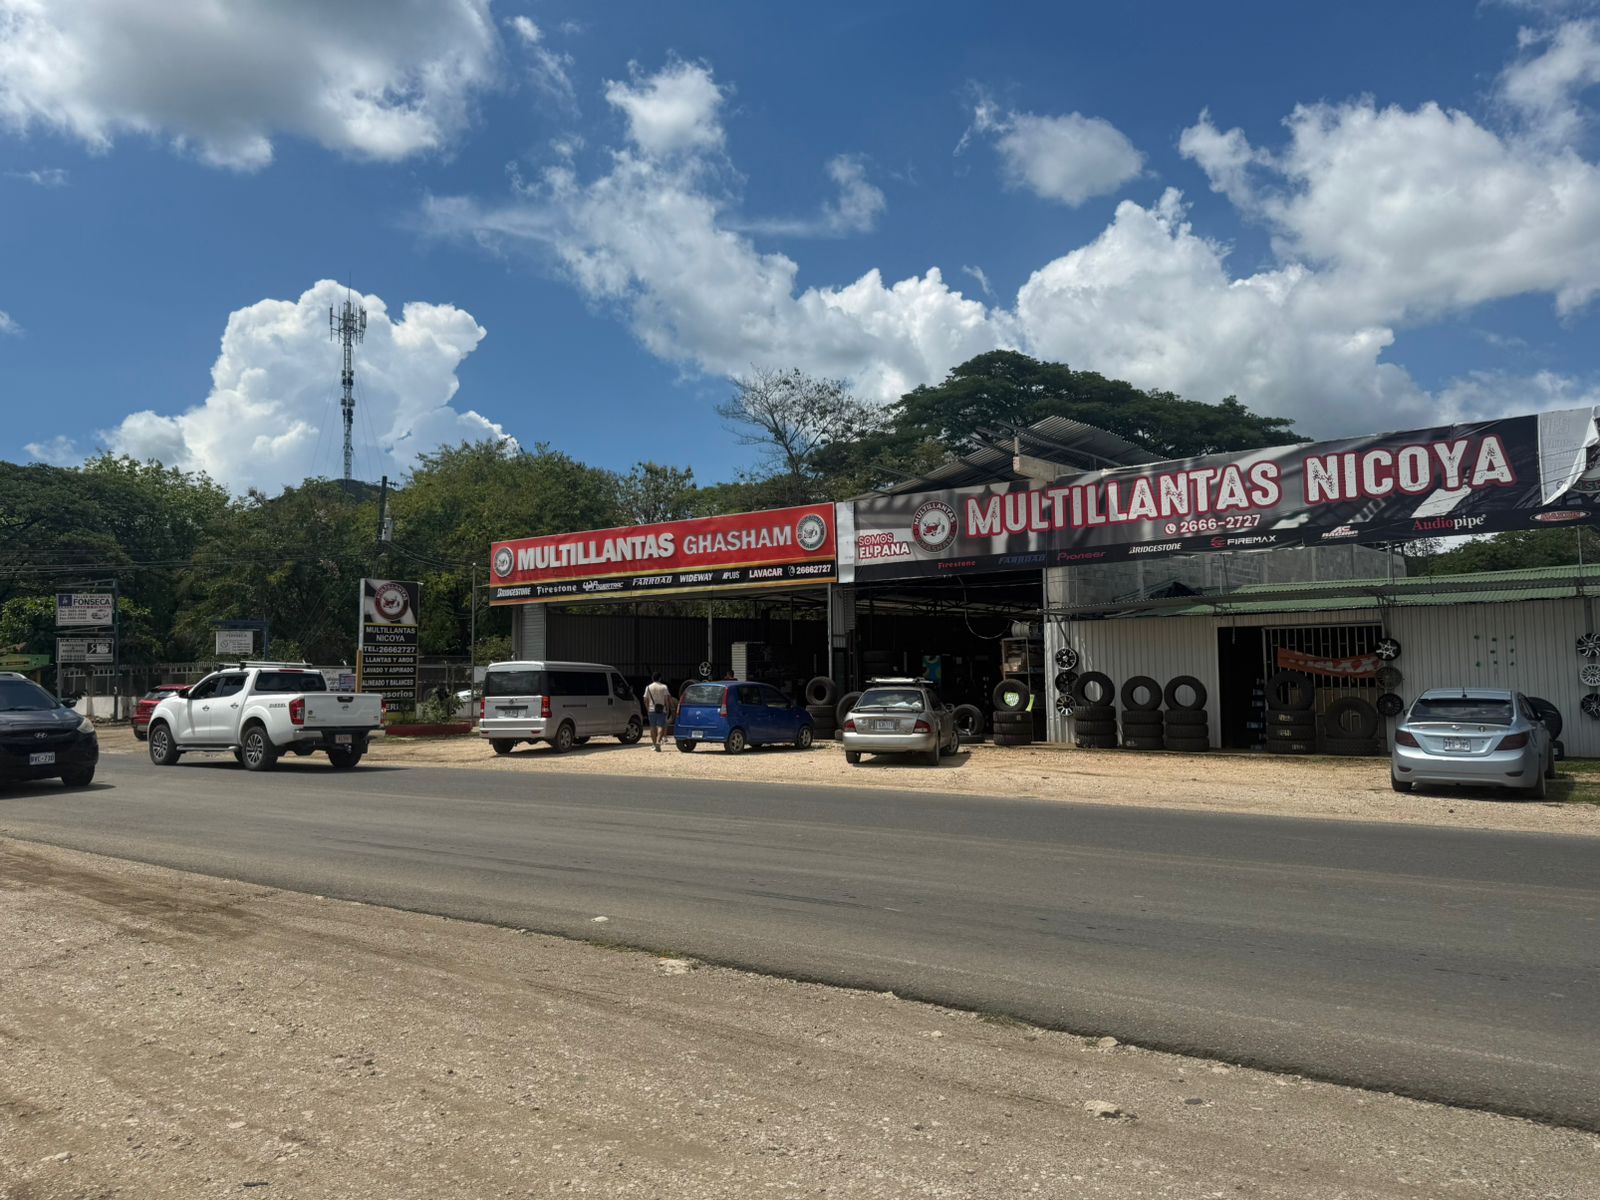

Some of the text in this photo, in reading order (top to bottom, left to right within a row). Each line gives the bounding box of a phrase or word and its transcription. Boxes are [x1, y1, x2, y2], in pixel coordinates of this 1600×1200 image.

[967, 435, 1514, 536] MULTILLANTAS NICOYA
[914, 503, 956, 525] MULTILLANTAS
[1180, 514, 1261, 534] 2666-2727
[1412, 514, 1485, 531] Audiopipe
[517, 532, 676, 572] MULTILLANTAS
[682, 525, 793, 556] GHASHAM
[858, 533, 894, 546] SOMOS
[859, 543, 911, 559] EL PANA
[937, 560, 976, 570] Firestone
[1057, 551, 1107, 561] Pioneer
[1129, 542, 1182, 554] BRIDGESTONE
[1227, 535, 1277, 546] FIREMAX
[536, 584, 578, 597] Firestone
[632, 575, 673, 587] FARROAD
[679, 572, 714, 583] WIDEWAY
[748, 567, 783, 578] LAVACAR
[795, 564, 832, 574] 26662727
[366, 626, 416, 635] MULTILLANTAS
[376, 634, 405, 642] NICOYA
